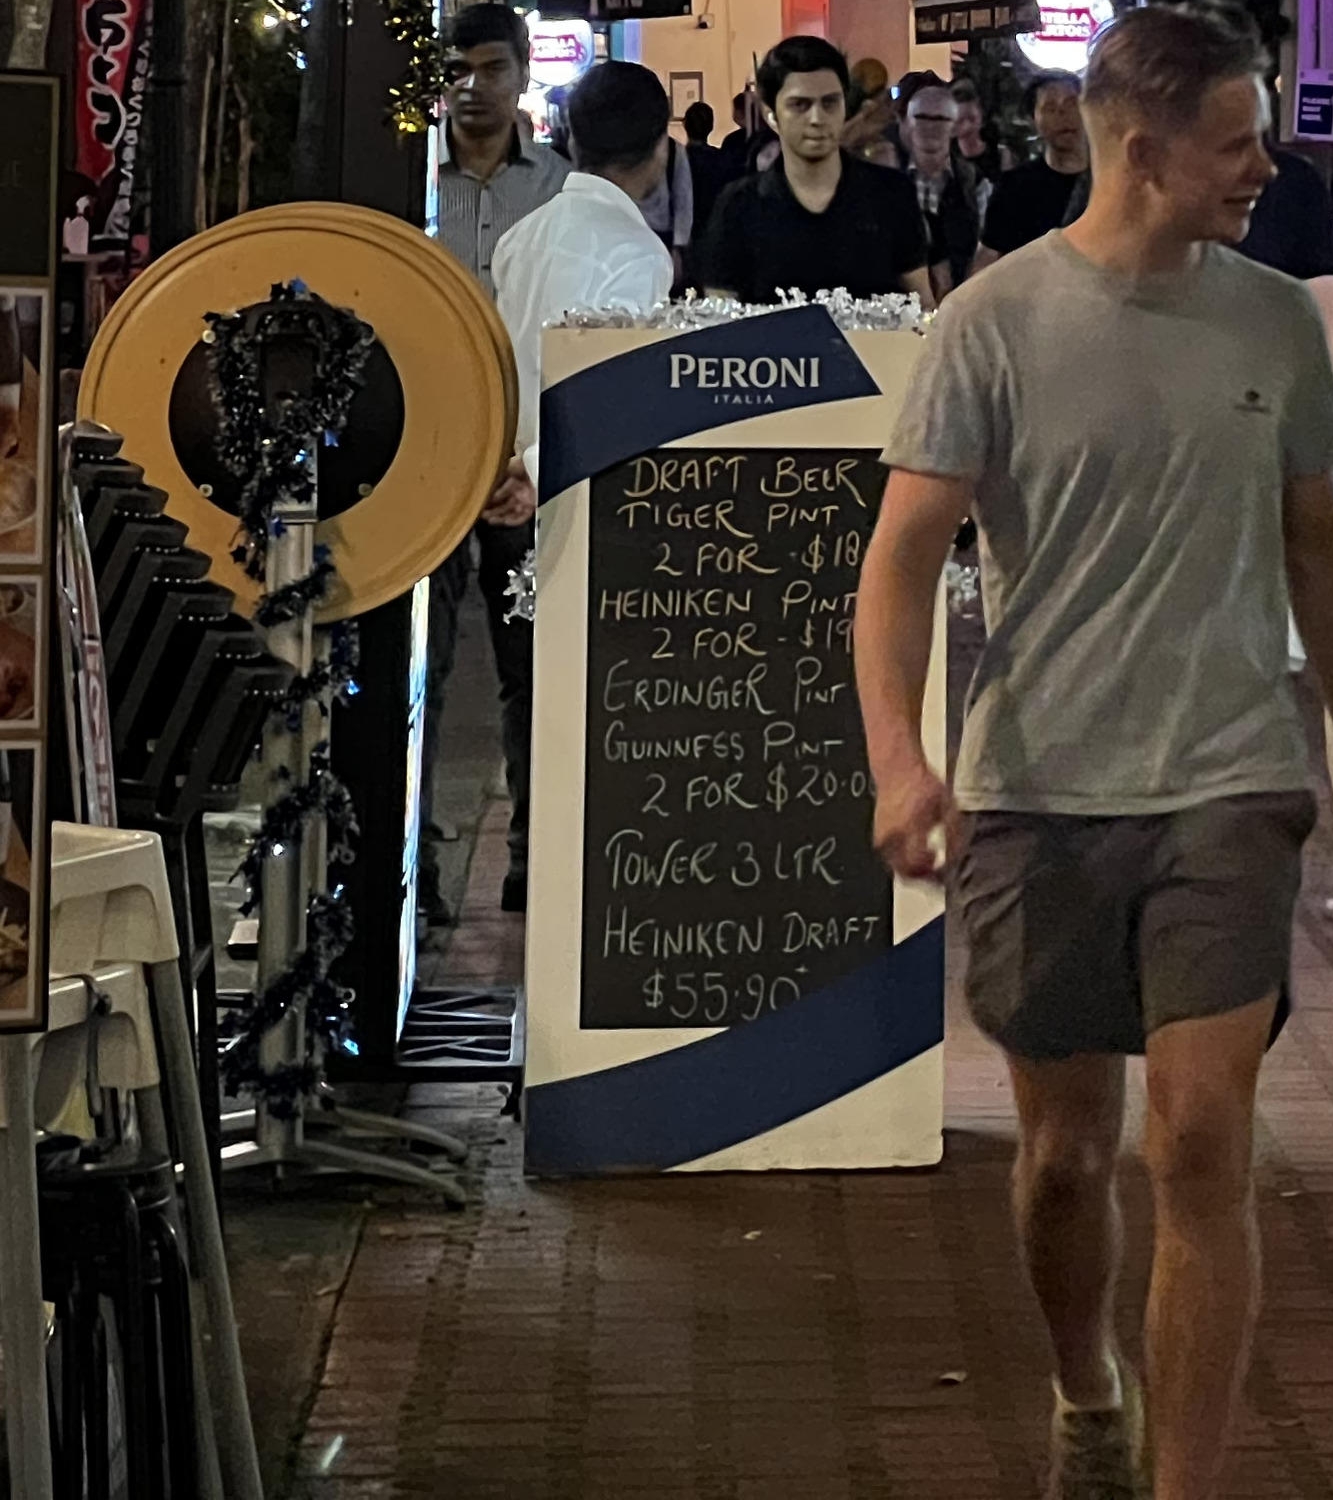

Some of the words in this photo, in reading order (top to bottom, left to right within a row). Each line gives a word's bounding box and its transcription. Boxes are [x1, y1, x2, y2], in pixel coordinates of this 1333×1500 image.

[669, 352, 819, 389] PERONI
[713, 393, 775, 405] ITALIA
[622, 455, 748, 499] DRAFT
[760, 455, 867, 509] BEER
[615, 500, 754, 539] TIGER
[766, 502, 840, 533] PINT
[653, 542, 684, 577] 2
[696, 542, 782, 574] FOR
[781, 579, 858, 620] PINT
[651, 628, 676, 660] 2
[692, 627, 768, 660] FOR
[602, 660, 777, 715] ERDINGER
[793, 656, 848, 713] PINT
[763, 721, 845, 762] PINT
[641, 773, 671, 817] 2
[685, 772, 759, 813] FOR
[604, 828, 719, 889] TOWER
[730, 841, 761, 887] 3
[782, 911, 882, 953] DRAFT
